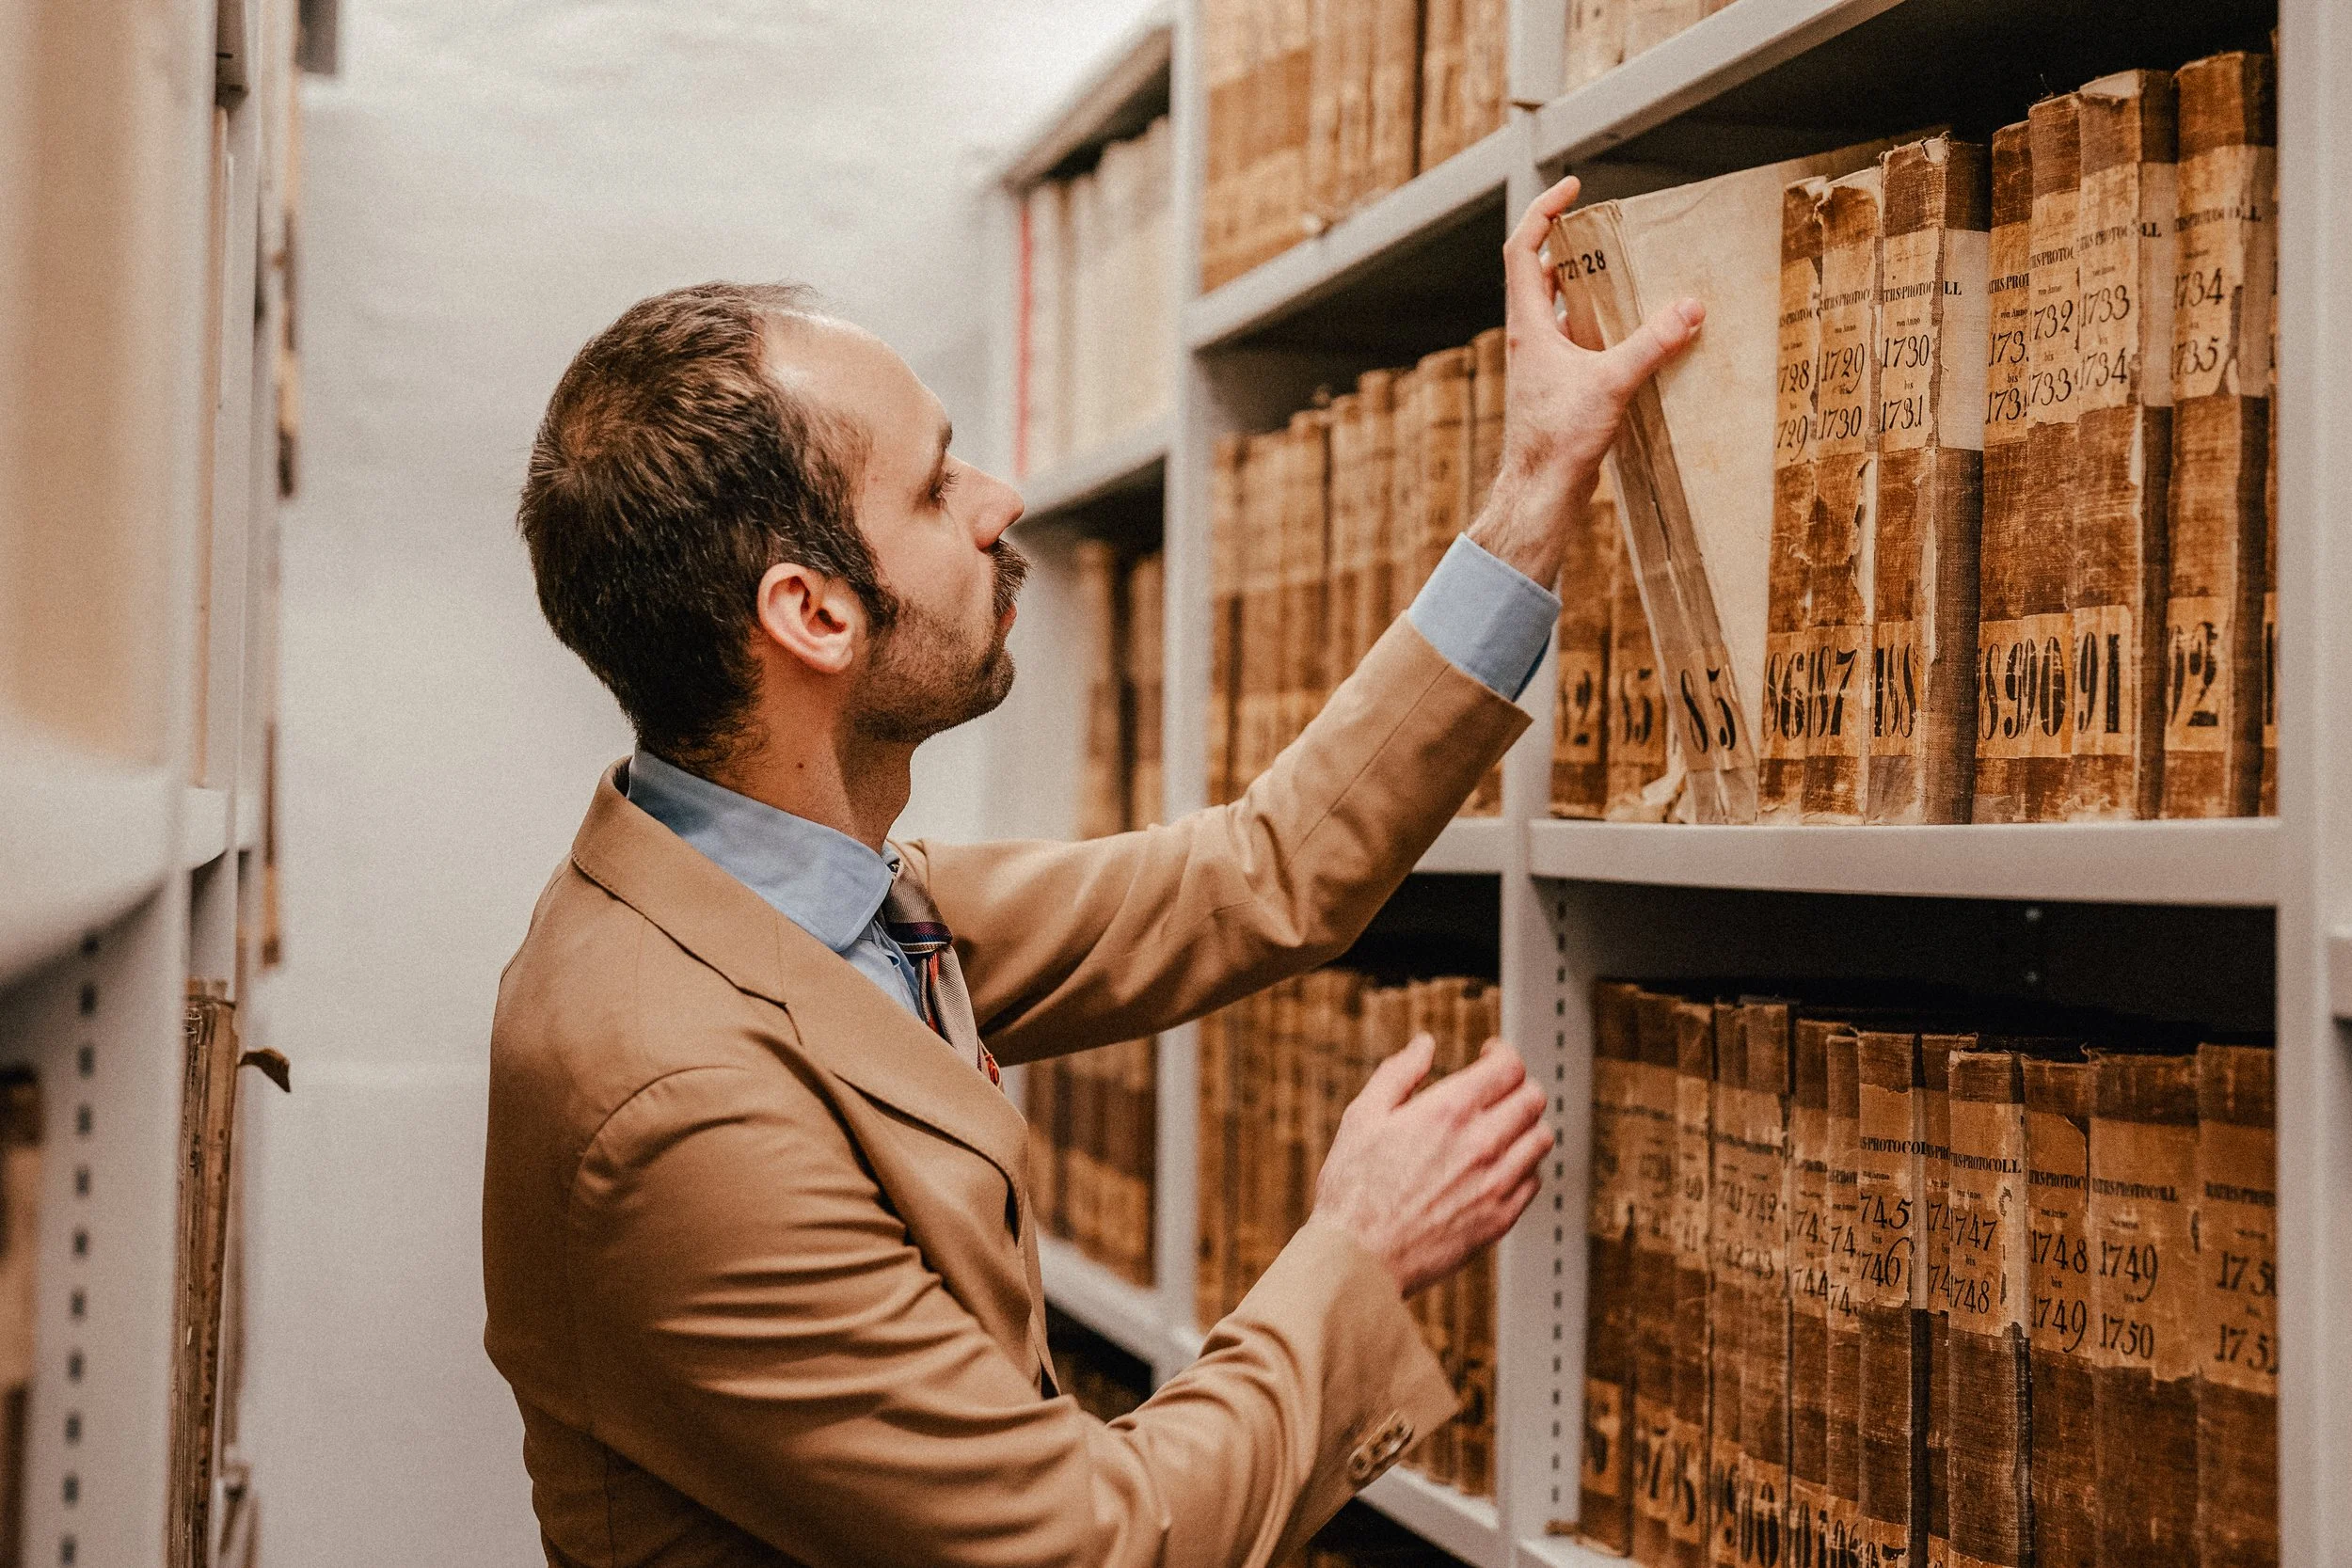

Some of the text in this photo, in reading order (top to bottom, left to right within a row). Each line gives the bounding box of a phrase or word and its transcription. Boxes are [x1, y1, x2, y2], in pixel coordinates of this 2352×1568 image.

[1581, 249, 1606, 274] 28
[2081, 284, 2130, 327] 1733
[2173, 267, 2224, 310] 1734
[1821, 341, 1865, 395] 1729
[1883, 334, 1930, 369] 1730
[1989, 330, 2029, 367] 173
[2080, 346, 2128, 391] 1734
[2007, 372, 2019, 384] bis
[1819, 405, 1862, 441] 1730
[1881, 394, 1924, 435] 1731
[1985, 388, 2027, 424] 173
[1860, 1191, 1914, 1230] 745
[1859, 1236, 1915, 1288] 746
[1965, 1253, 1976, 1266] bis
[2031, 1228, 2088, 1275] 1748
[2099, 1239, 2159, 1303] 1749
[2051, 1275, 2063, 1289] bis
[2215, 1250, 2277, 1298] 175
[1830, 1284, 1859, 1317] 74
[2031, 1293, 2088, 1354] 1749
[2099, 1310, 2154, 1360] 1750
